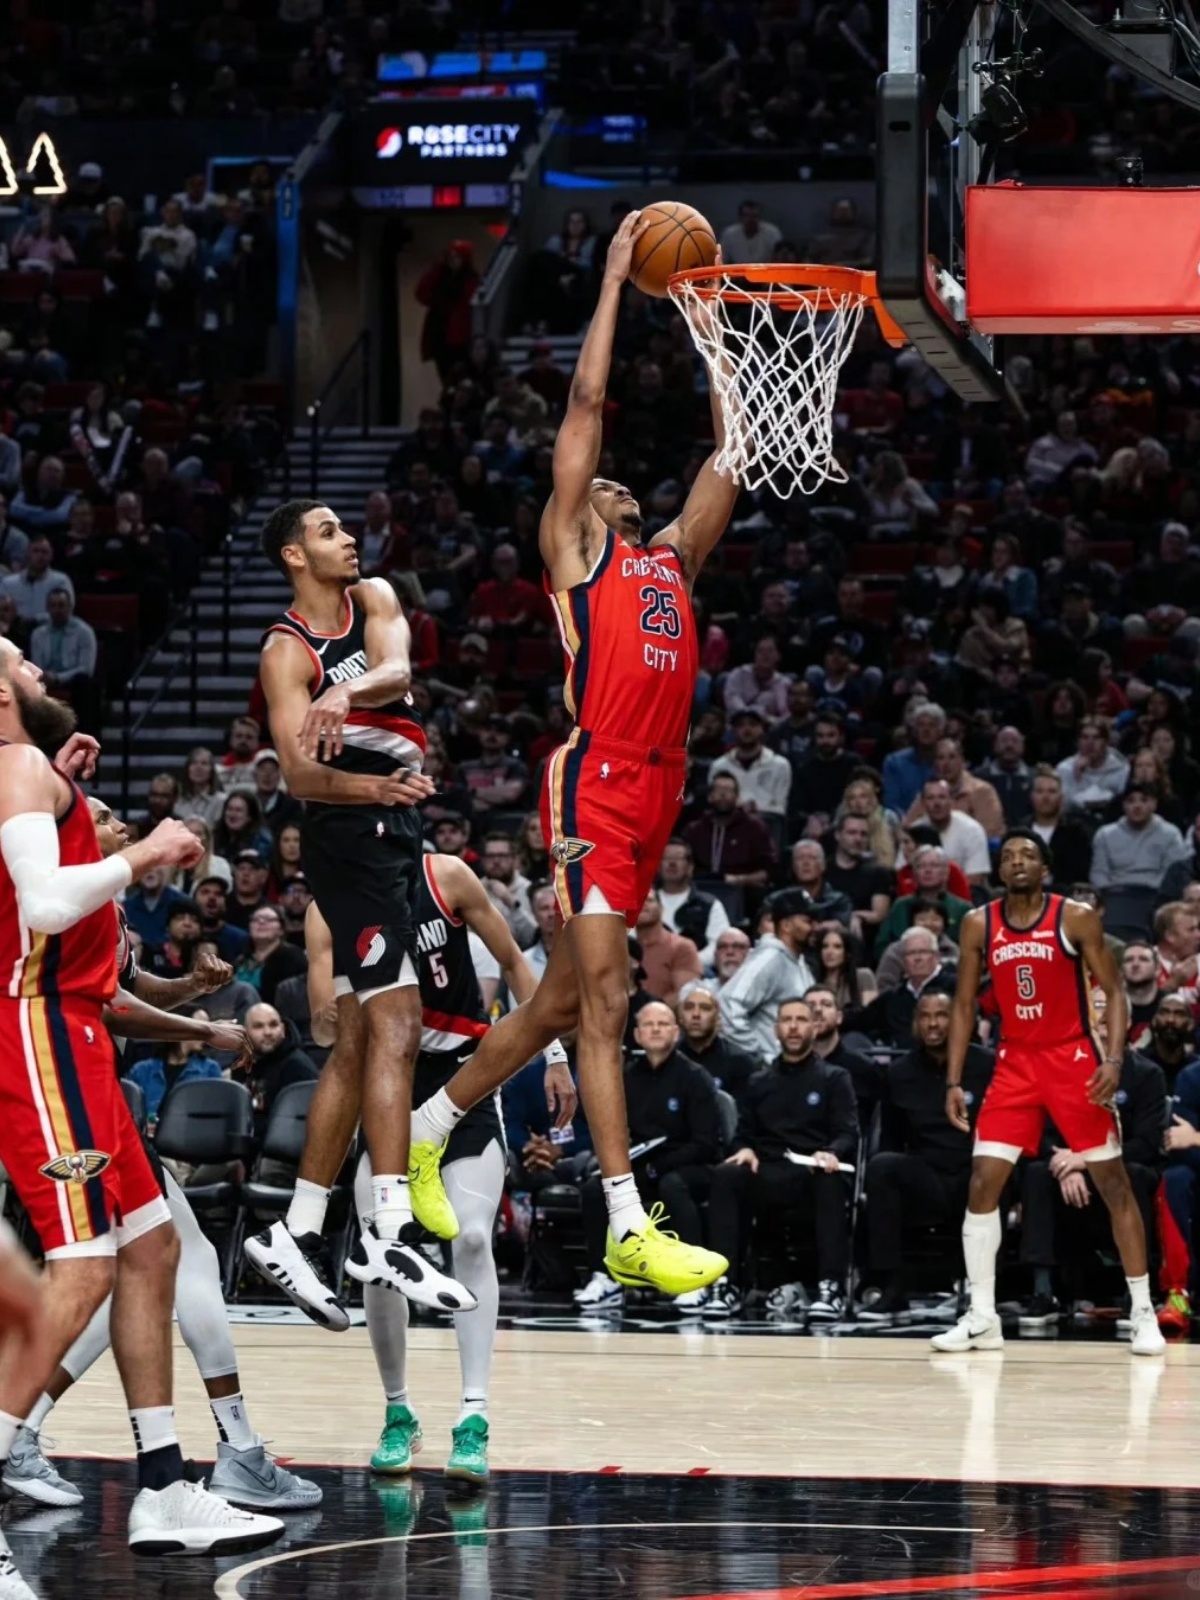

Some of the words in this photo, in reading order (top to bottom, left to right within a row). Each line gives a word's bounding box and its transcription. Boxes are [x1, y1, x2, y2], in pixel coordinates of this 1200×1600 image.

[420, 143, 507, 157] PARTNERS
[622, 556, 683, 590] CREENT
[640, 585, 681, 639] 25
[643, 643, 678, 672] CITY
[992, 941, 1055, 966] CRESCENT
[428, 951, 449, 989] 5
[1016, 964, 1036, 1000] 5
[1015, 1002, 1043, 1020] CITY
